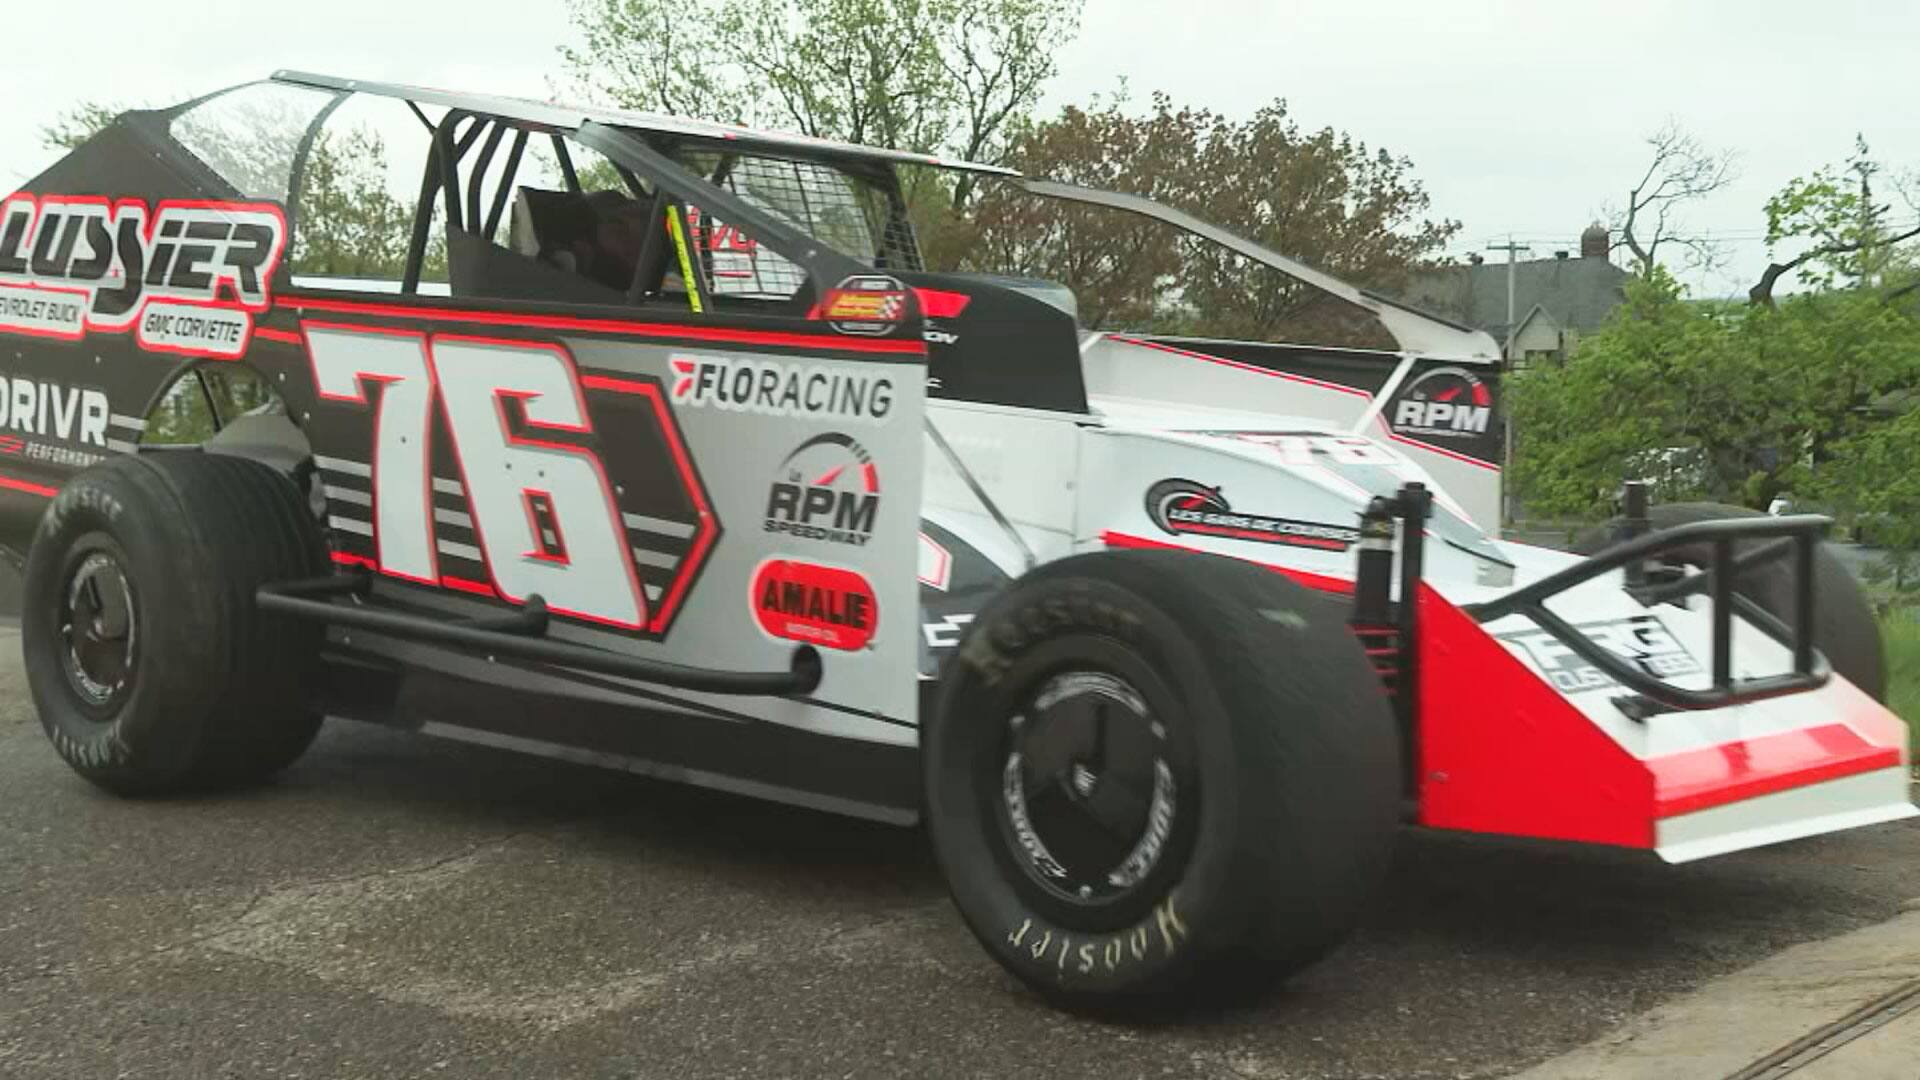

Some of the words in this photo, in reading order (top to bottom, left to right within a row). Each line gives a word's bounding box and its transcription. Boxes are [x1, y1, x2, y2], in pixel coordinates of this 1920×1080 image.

[175, 316, 242, 342] CORVETTE
[1395, 399, 1492, 433] RPM
[300, 319, 648, 631] 76
[767, 481, 880, 534] RPM
[763, 519, 875, 546] SPEEDWAY
[762, 576, 871, 629] AMALIE
